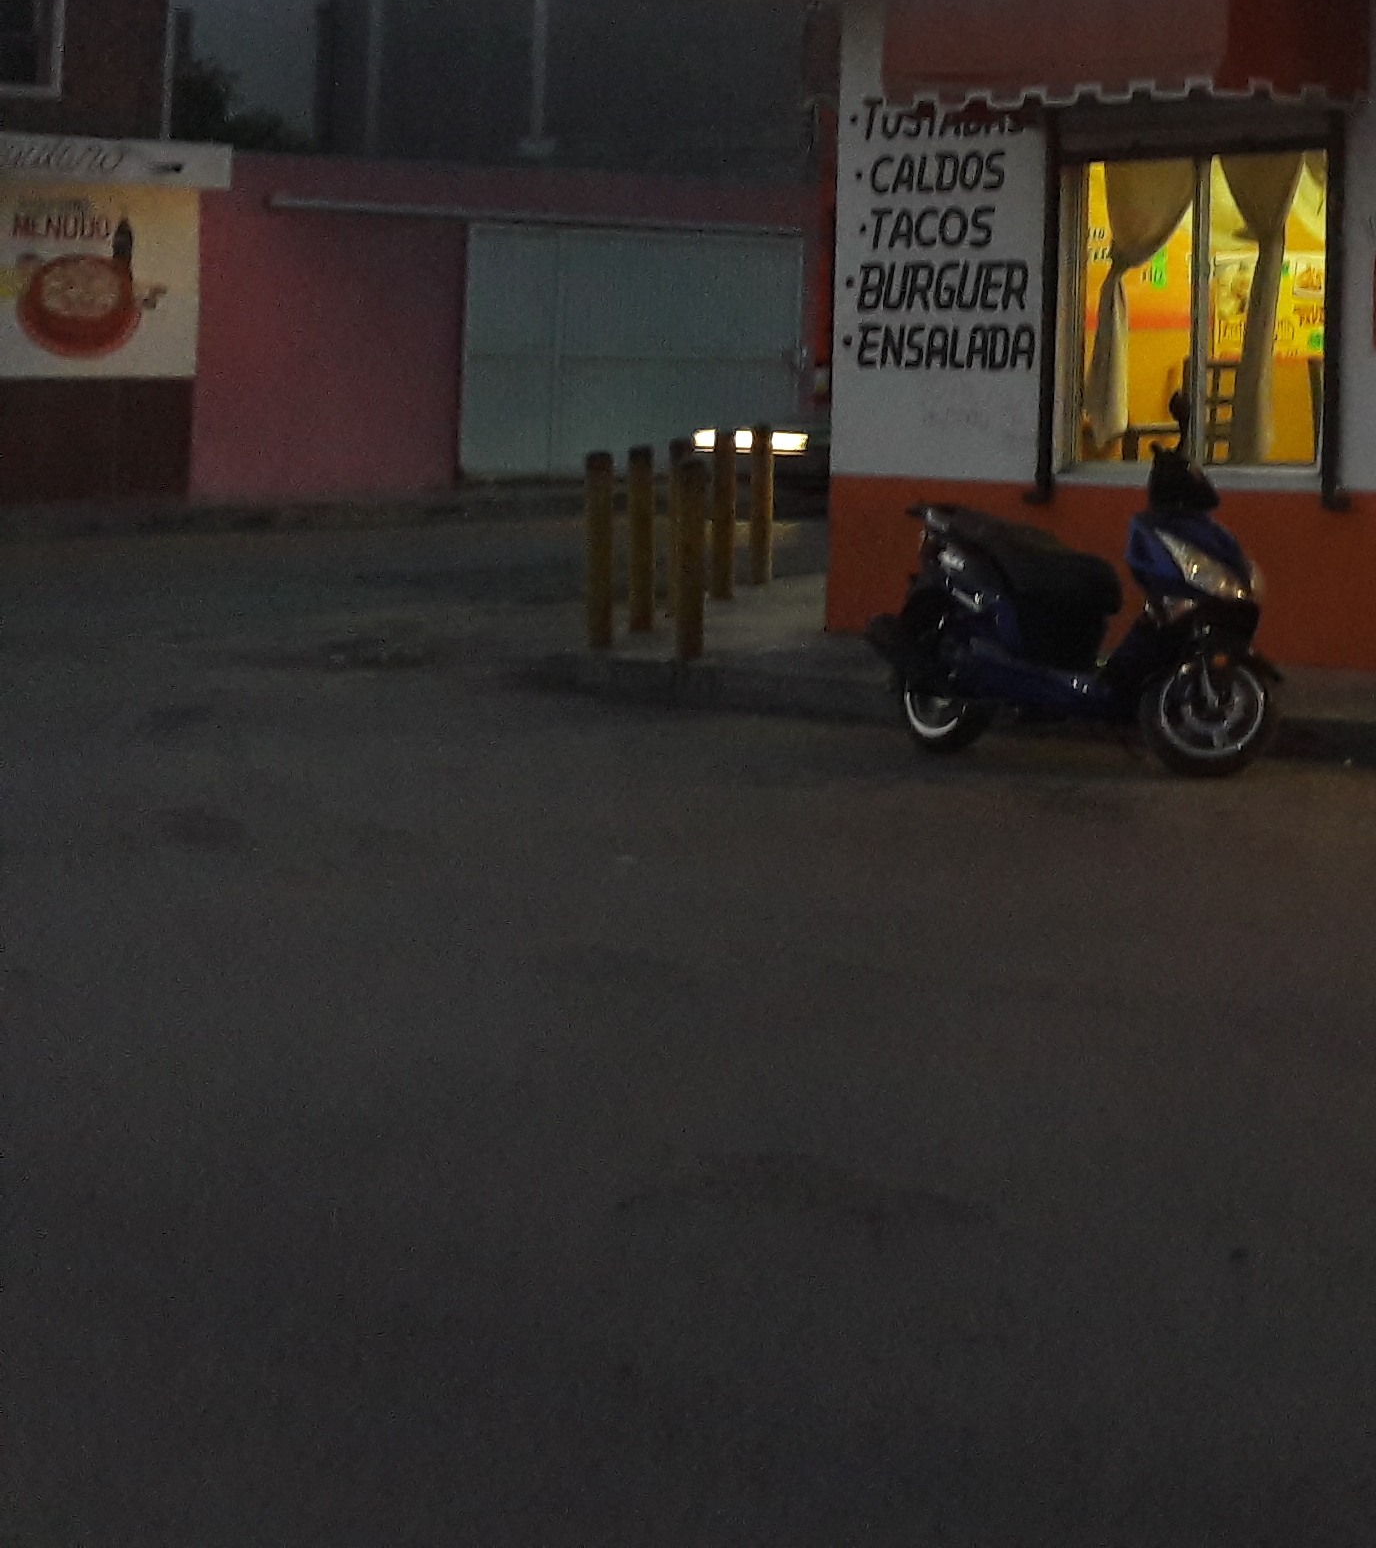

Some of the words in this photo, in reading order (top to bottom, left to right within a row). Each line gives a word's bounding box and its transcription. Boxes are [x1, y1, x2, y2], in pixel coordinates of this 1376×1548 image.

[869, 149, 1006, 196] CALDOS
[868, 206, 996, 250] TACOS
[857, 260, 1029, 313] BURGUER
[857, 322, 1036, 371] ENSALADA
